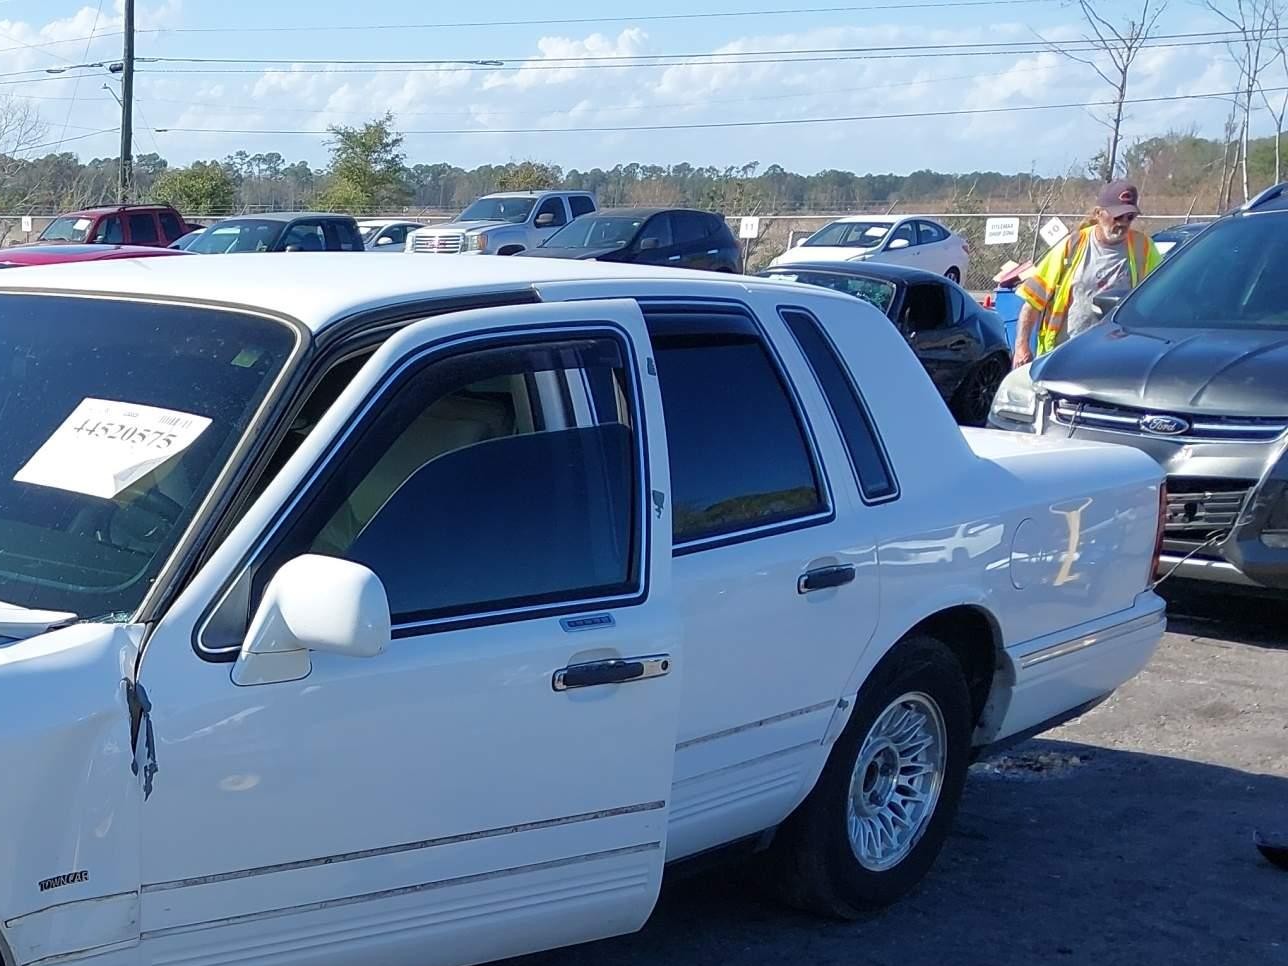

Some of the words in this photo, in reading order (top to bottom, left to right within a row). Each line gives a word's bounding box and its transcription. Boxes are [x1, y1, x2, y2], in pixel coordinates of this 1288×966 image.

[1048, 225, 1060, 236] 10
[1149, 418, 1177, 431] Ford
[73, 419, 178, 449] 44520575
